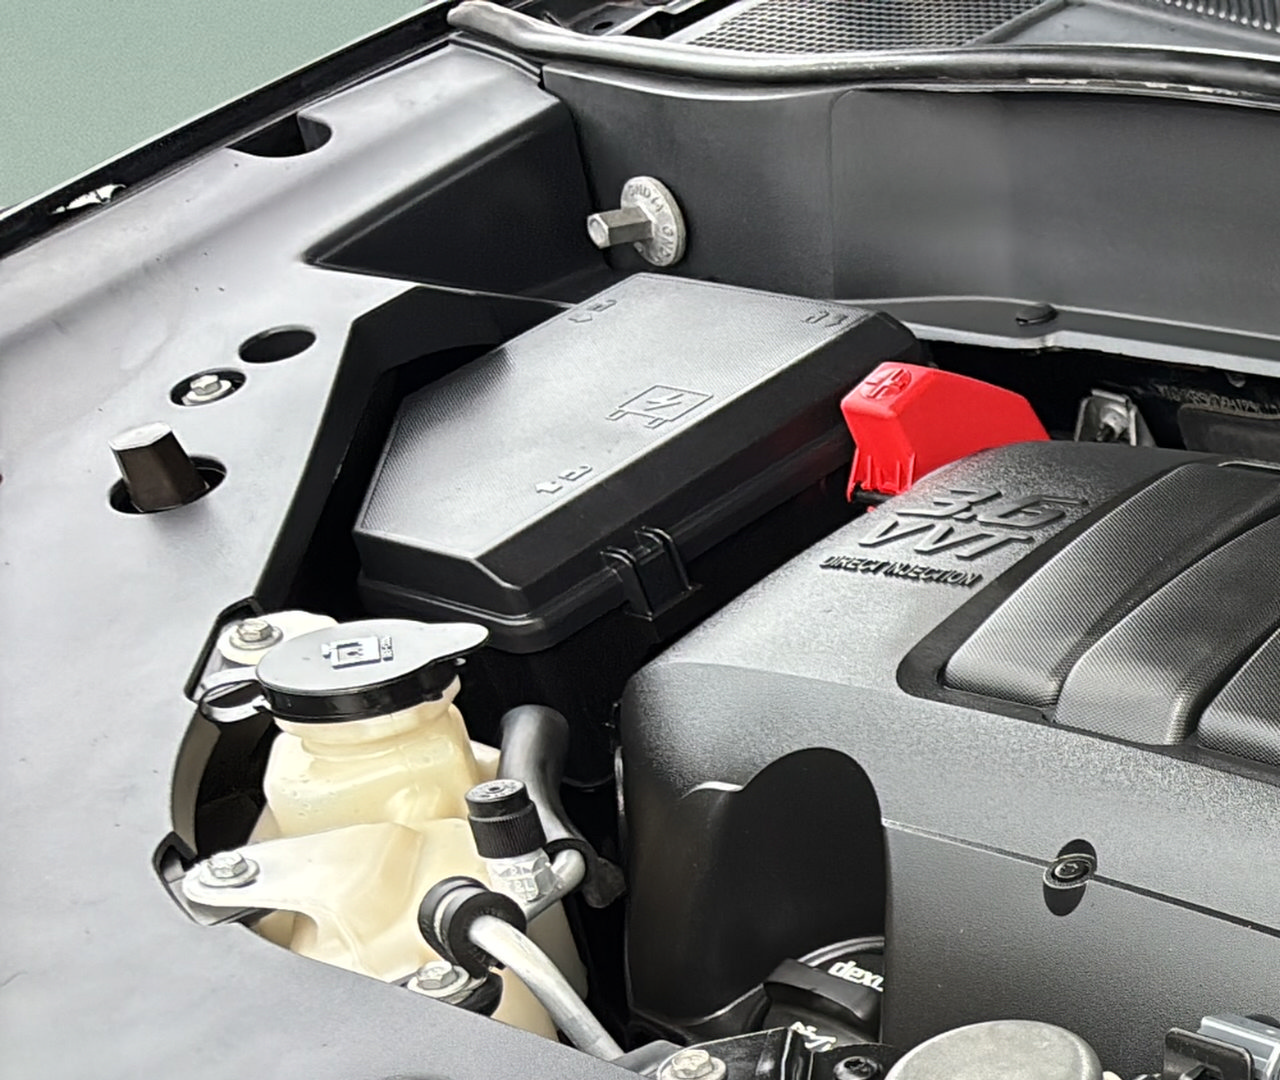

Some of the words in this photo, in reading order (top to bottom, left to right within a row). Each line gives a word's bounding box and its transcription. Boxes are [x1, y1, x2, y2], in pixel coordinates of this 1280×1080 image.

[896, 487, 1090, 529] 3.6
[858, 520, 1035, 561] VVT
[819, 554, 886, 580] DIRECT
[881, 560, 984, 587] INJECTION
